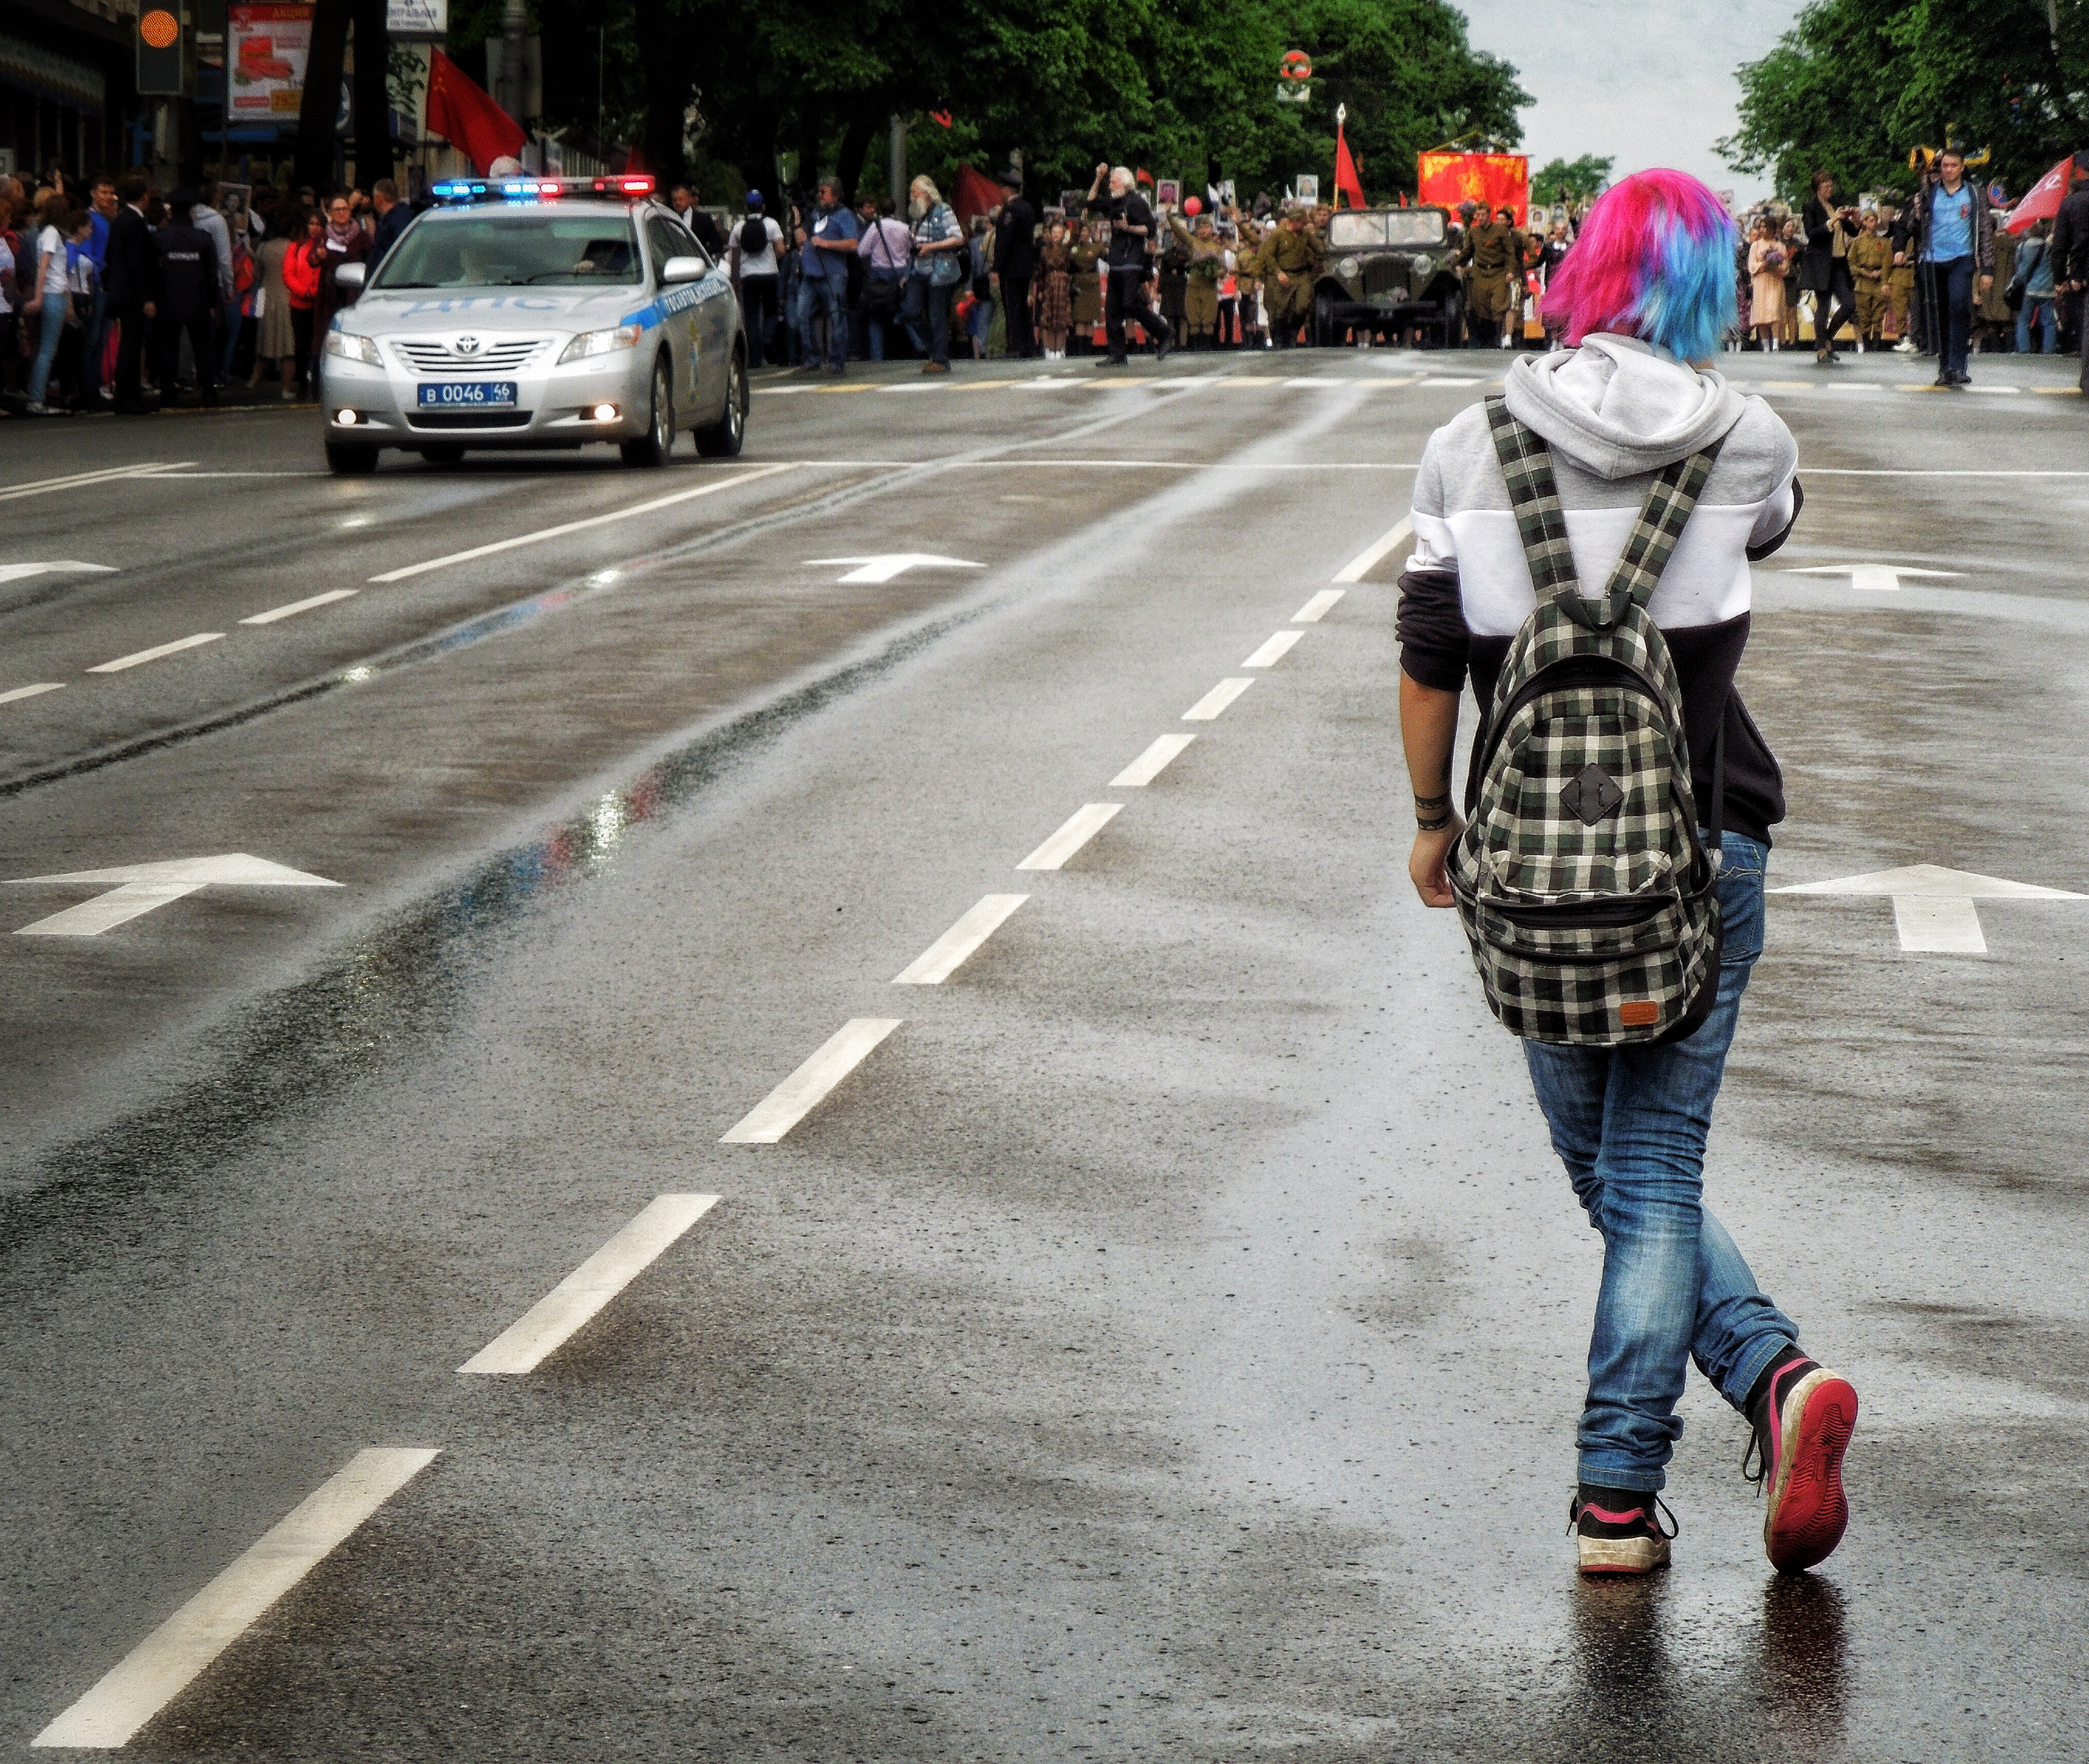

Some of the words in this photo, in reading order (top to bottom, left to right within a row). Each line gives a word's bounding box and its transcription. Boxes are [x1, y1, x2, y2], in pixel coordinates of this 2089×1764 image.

[401, 296, 560, 318] ДПС
[442, 385, 484, 401] 0046
[494, 383, 510, 397] 46
